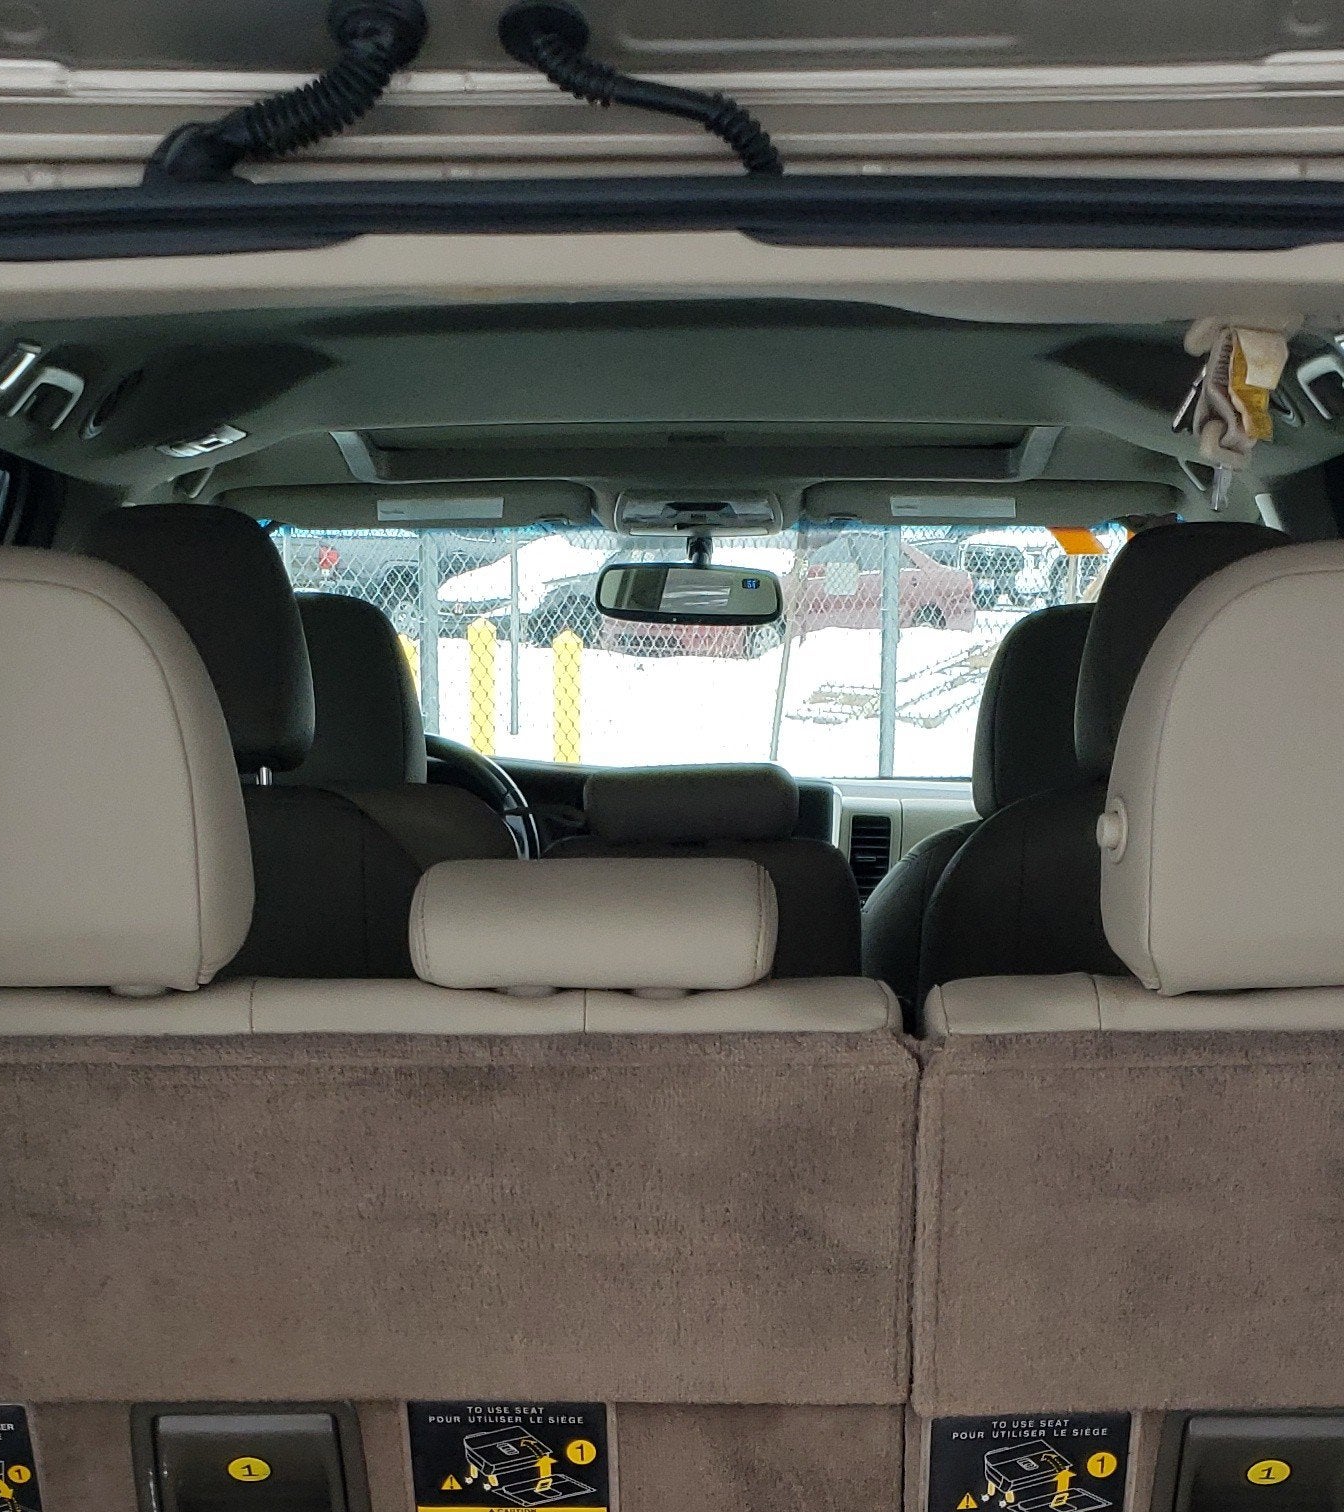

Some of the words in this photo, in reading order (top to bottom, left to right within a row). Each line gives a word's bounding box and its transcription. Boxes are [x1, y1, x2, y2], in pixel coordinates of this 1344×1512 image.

[467, 1406, 483, 1414] TO
[487, 1406, 510, 1414] USE
[468, 1415, 522, 1423] UTILISER
[529, 1416, 544, 1424] LE
[992, 1421, 1007, 1429] TO
[1012, 1420, 1035, 1428] USE
[1040, 1419, 1069, 1427] SEAT
[952, 1431, 985, 1439] POUR
[992, 1429, 1046, 1438] UTILISER
[1053, 1429, 1067, 1437] LE
[575, 1444, 585, 1461] 1
[241, 1464, 258, 1476] 1
[1096, 1456, 1106, 1474] 1
[1259, 1467, 1275, 1479] 1
